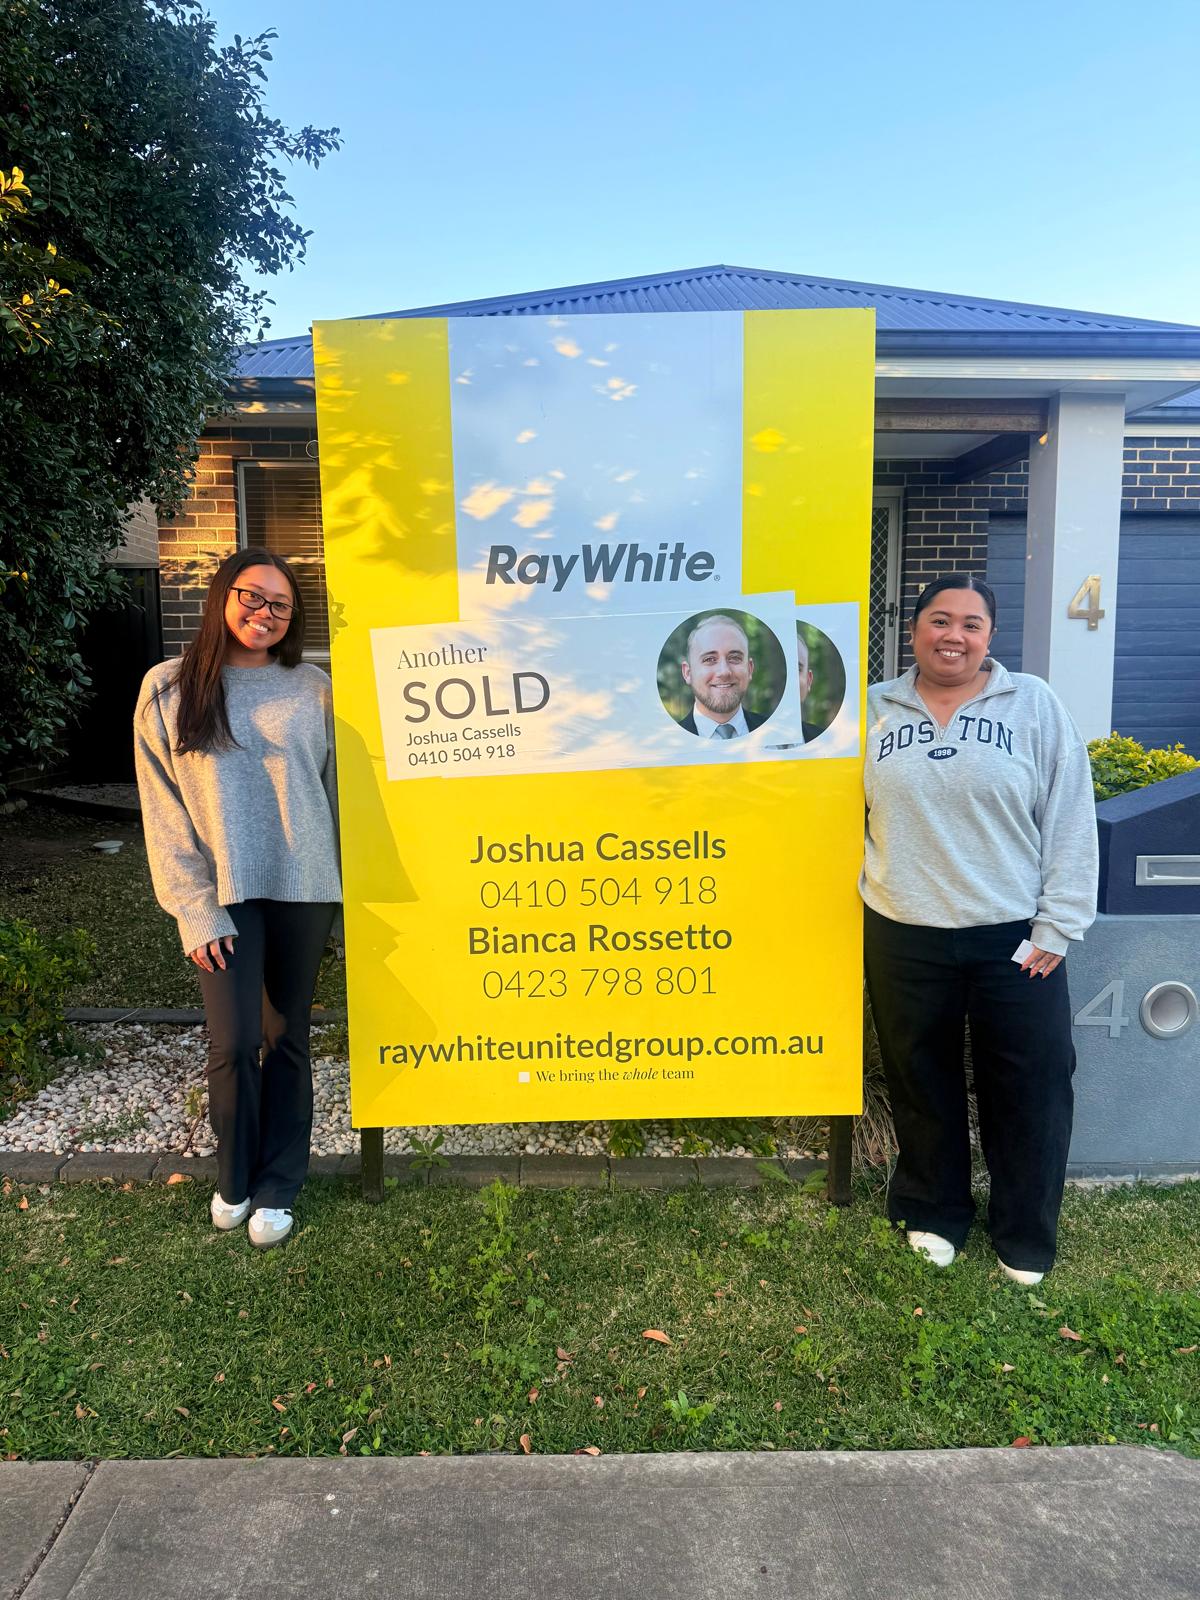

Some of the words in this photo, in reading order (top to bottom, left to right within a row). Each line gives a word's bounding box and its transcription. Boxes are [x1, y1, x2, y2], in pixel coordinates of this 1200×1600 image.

[1067, 575, 1105, 631] 4
[397, 644, 488, 669] Another
[403, 671, 551, 723] SOLD
[406, 731, 458, 746] Joshua
[462, 723, 522, 741] Cassells
[877, 714, 1014, 762] BOSTON
[408, 750, 448, 766] 0410
[453, 747, 482, 762] 504
[486, 744, 515, 759] 918
[470, 834, 584, 864] Joshua
[596, 831, 726, 862] Cassells
[481, 879, 566, 909] 0410
[579, 877, 642, 907] 504
[655, 875, 717, 905] 918
[469, 926, 576, 955] Bianca
[589, 923, 732, 953] Rossetto
[483, 968, 567, 999] 0423
[581, 967, 642, 997] 798
[656, 966, 717, 995] 801
[379, 1031, 824, 1068] raywhiteunitedgroup.com.au
[536, 1071, 555, 1083] We
[560, 1069, 595, 1083] bring
[599, 1068, 619, 1081] the
[622, 1068, 658, 1081] whole
[662, 1069, 694, 1080] team
